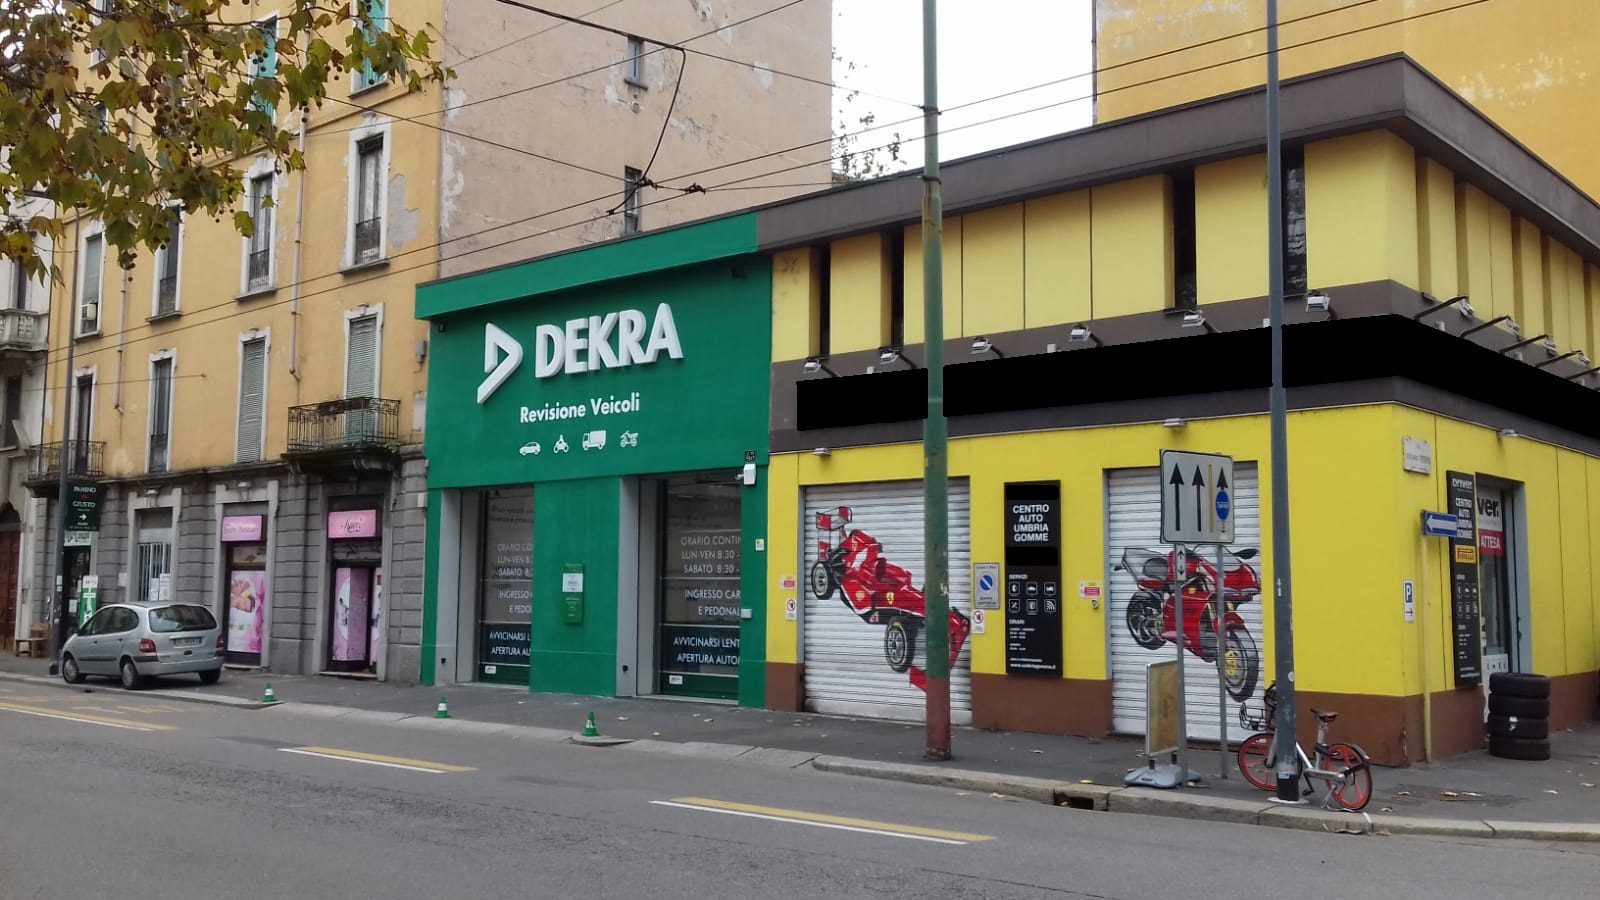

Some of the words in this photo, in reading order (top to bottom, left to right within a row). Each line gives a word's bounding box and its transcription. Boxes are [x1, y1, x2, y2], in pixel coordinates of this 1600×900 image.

[535, 302, 684, 378] DEKRA
[520, 402, 586, 423] Revisione
[590, 392, 640, 416] Veicoli
[1012, 504, 1050, 514] CENTRO
[1018, 514, 1044, 523] AUTO
[1013, 523, 1049, 532] UMBRIA
[681, 536, 711, 546] ORARIO
[1013, 533, 1049, 542] GOMME
[498, 567, 523, 577] SABATO
[683, 564, 713, 574] SABATO
[499, 590, 530, 599] INGRESSO
[684, 589, 723, 599] INGRESSO
[698, 606, 703, 616] E
[489, 631, 526, 641] AVVICINARSI
[673, 637, 720, 647] AVVICINARSI
[491, 646, 521, 656] APERTURA
[677, 653, 714, 664] APERTURA
